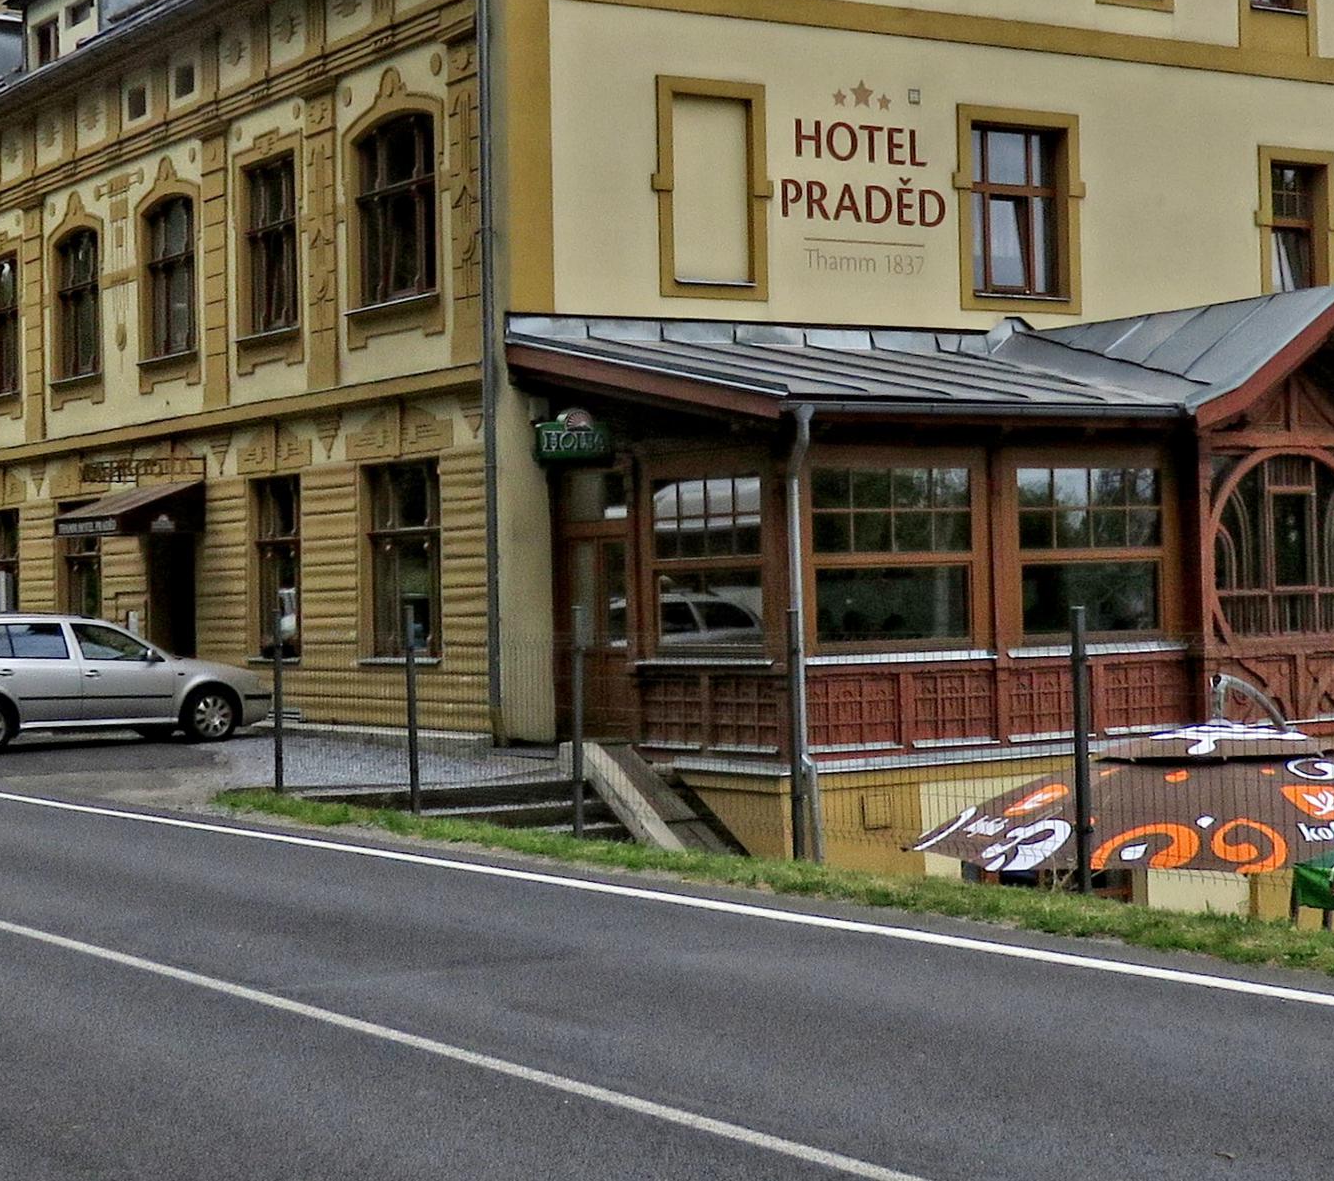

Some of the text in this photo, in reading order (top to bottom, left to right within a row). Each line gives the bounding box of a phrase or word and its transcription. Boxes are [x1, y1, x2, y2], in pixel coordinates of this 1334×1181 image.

[794, 118, 928, 167] HOTEL
[781, 177, 946, 228] PRADĚD
[804, 248, 925, 276] Thamm 1837
[542, 430, 605, 452] HOLBA
